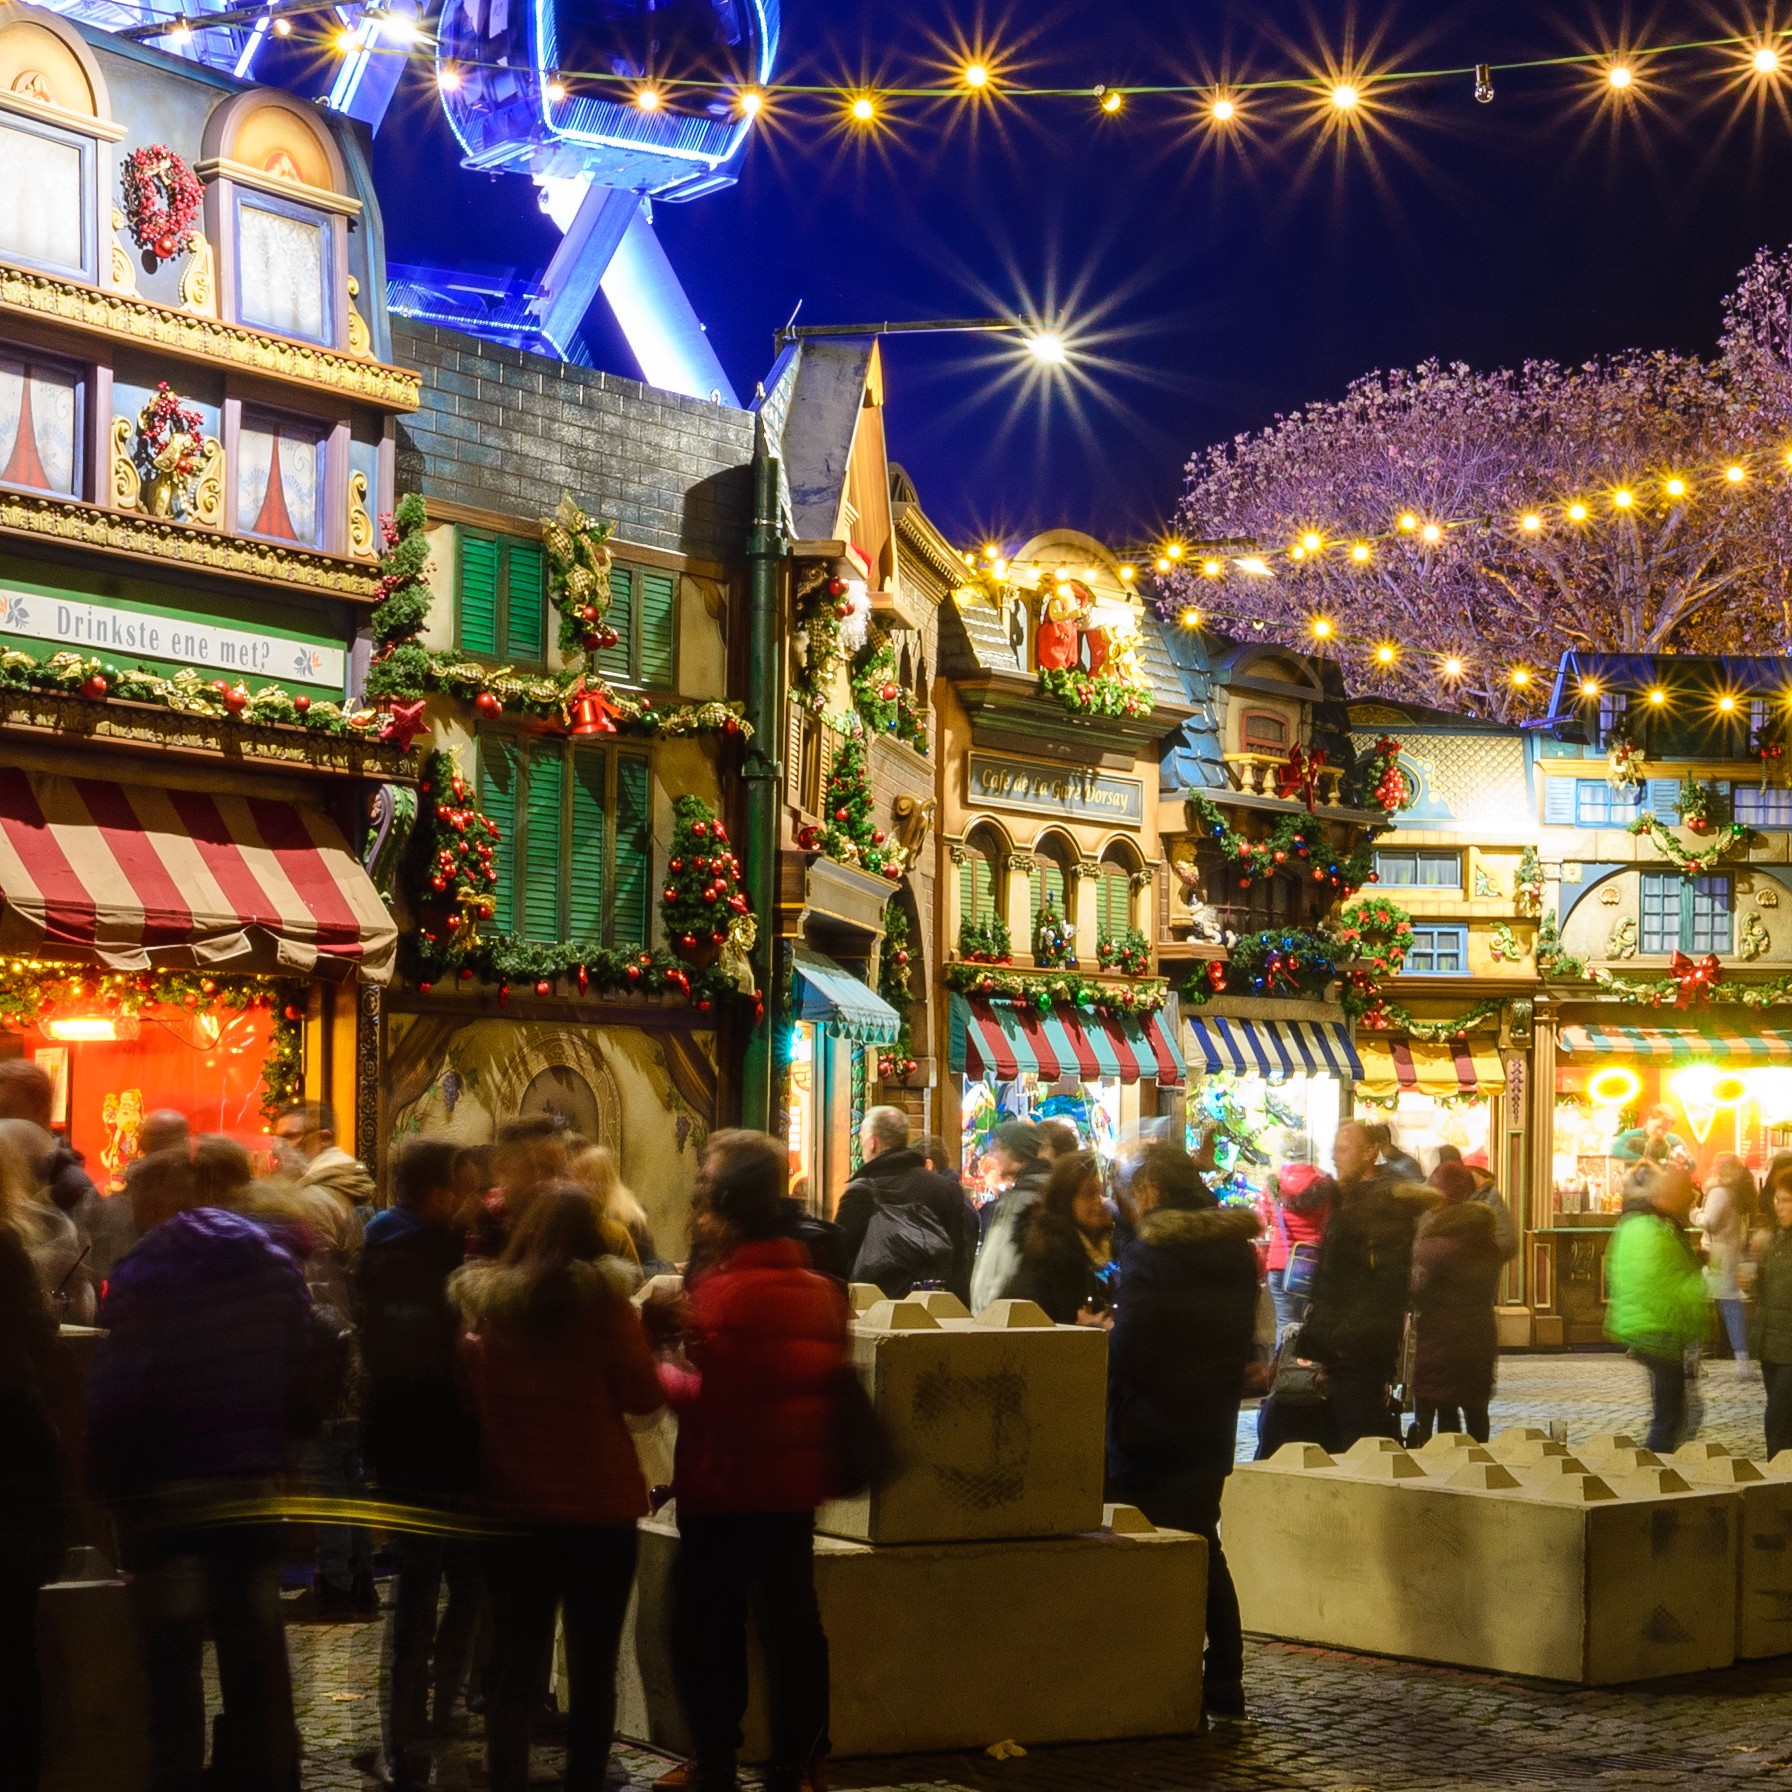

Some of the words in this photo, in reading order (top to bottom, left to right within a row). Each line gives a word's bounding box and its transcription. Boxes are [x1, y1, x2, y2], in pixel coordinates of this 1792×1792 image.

[57, 605, 159, 651] Drinkste
[171, 632, 208, 660] ene
[220, 640, 270, 669] met?
[1013, 771, 1029, 794] de
[1032, 776, 1048, 796] La
[1051, 779, 1081, 802] Gare
